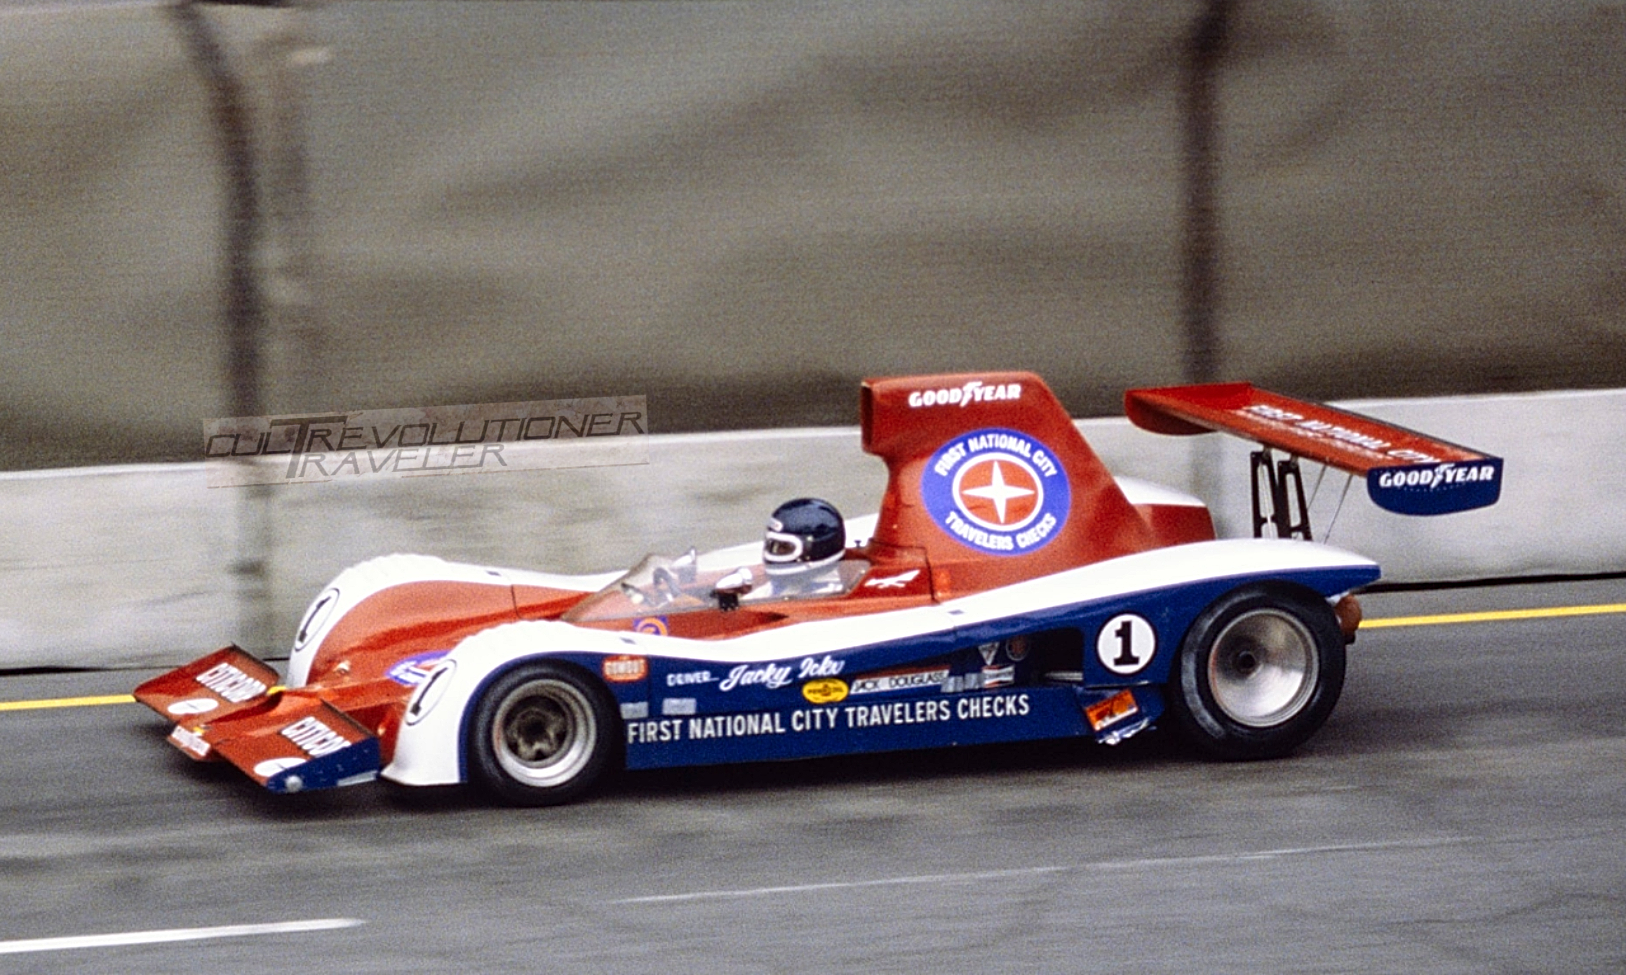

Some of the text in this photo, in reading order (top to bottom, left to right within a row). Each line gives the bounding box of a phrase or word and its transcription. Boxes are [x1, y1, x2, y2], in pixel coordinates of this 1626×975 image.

[908, 381, 1022, 407] GOODYEAR
[934, 433, 1058, 478] FIRST NATIONAL CITY
[1378, 463, 1495, 489] GOODYEAR
[945, 511, 1057, 550] TRAVELERS CHECKS
[1113, 620, 1140, 667] 1
[719, 663, 794, 691] Jacky
[628, 694, 1030, 744] FIRST NATIONAL CITY TRAVELERS CHECKS
